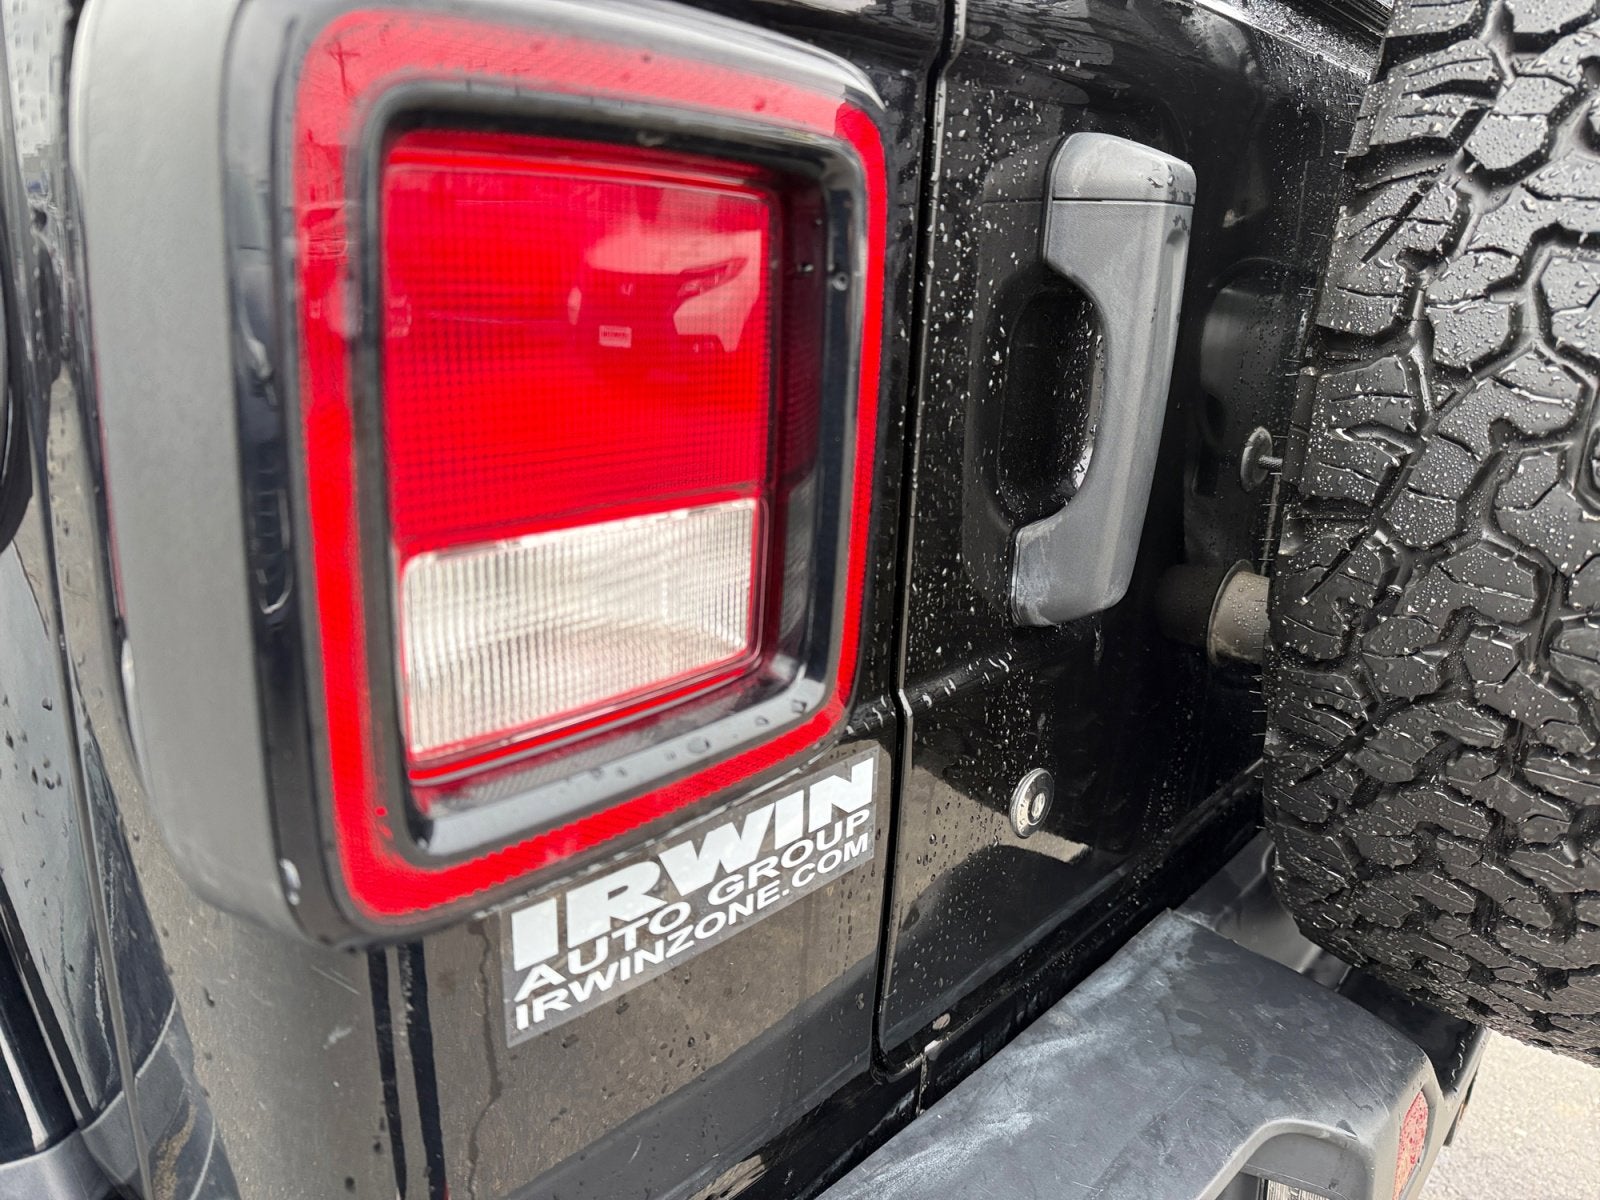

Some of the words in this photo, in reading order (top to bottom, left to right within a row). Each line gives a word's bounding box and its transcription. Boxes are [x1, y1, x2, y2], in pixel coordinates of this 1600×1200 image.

[511, 757, 874, 971] IRWIN
[514, 901, 691, 1002] AUTO
[707, 809, 870, 905] GROUP
[515, 832, 868, 1030] IRWINZONE.COM
